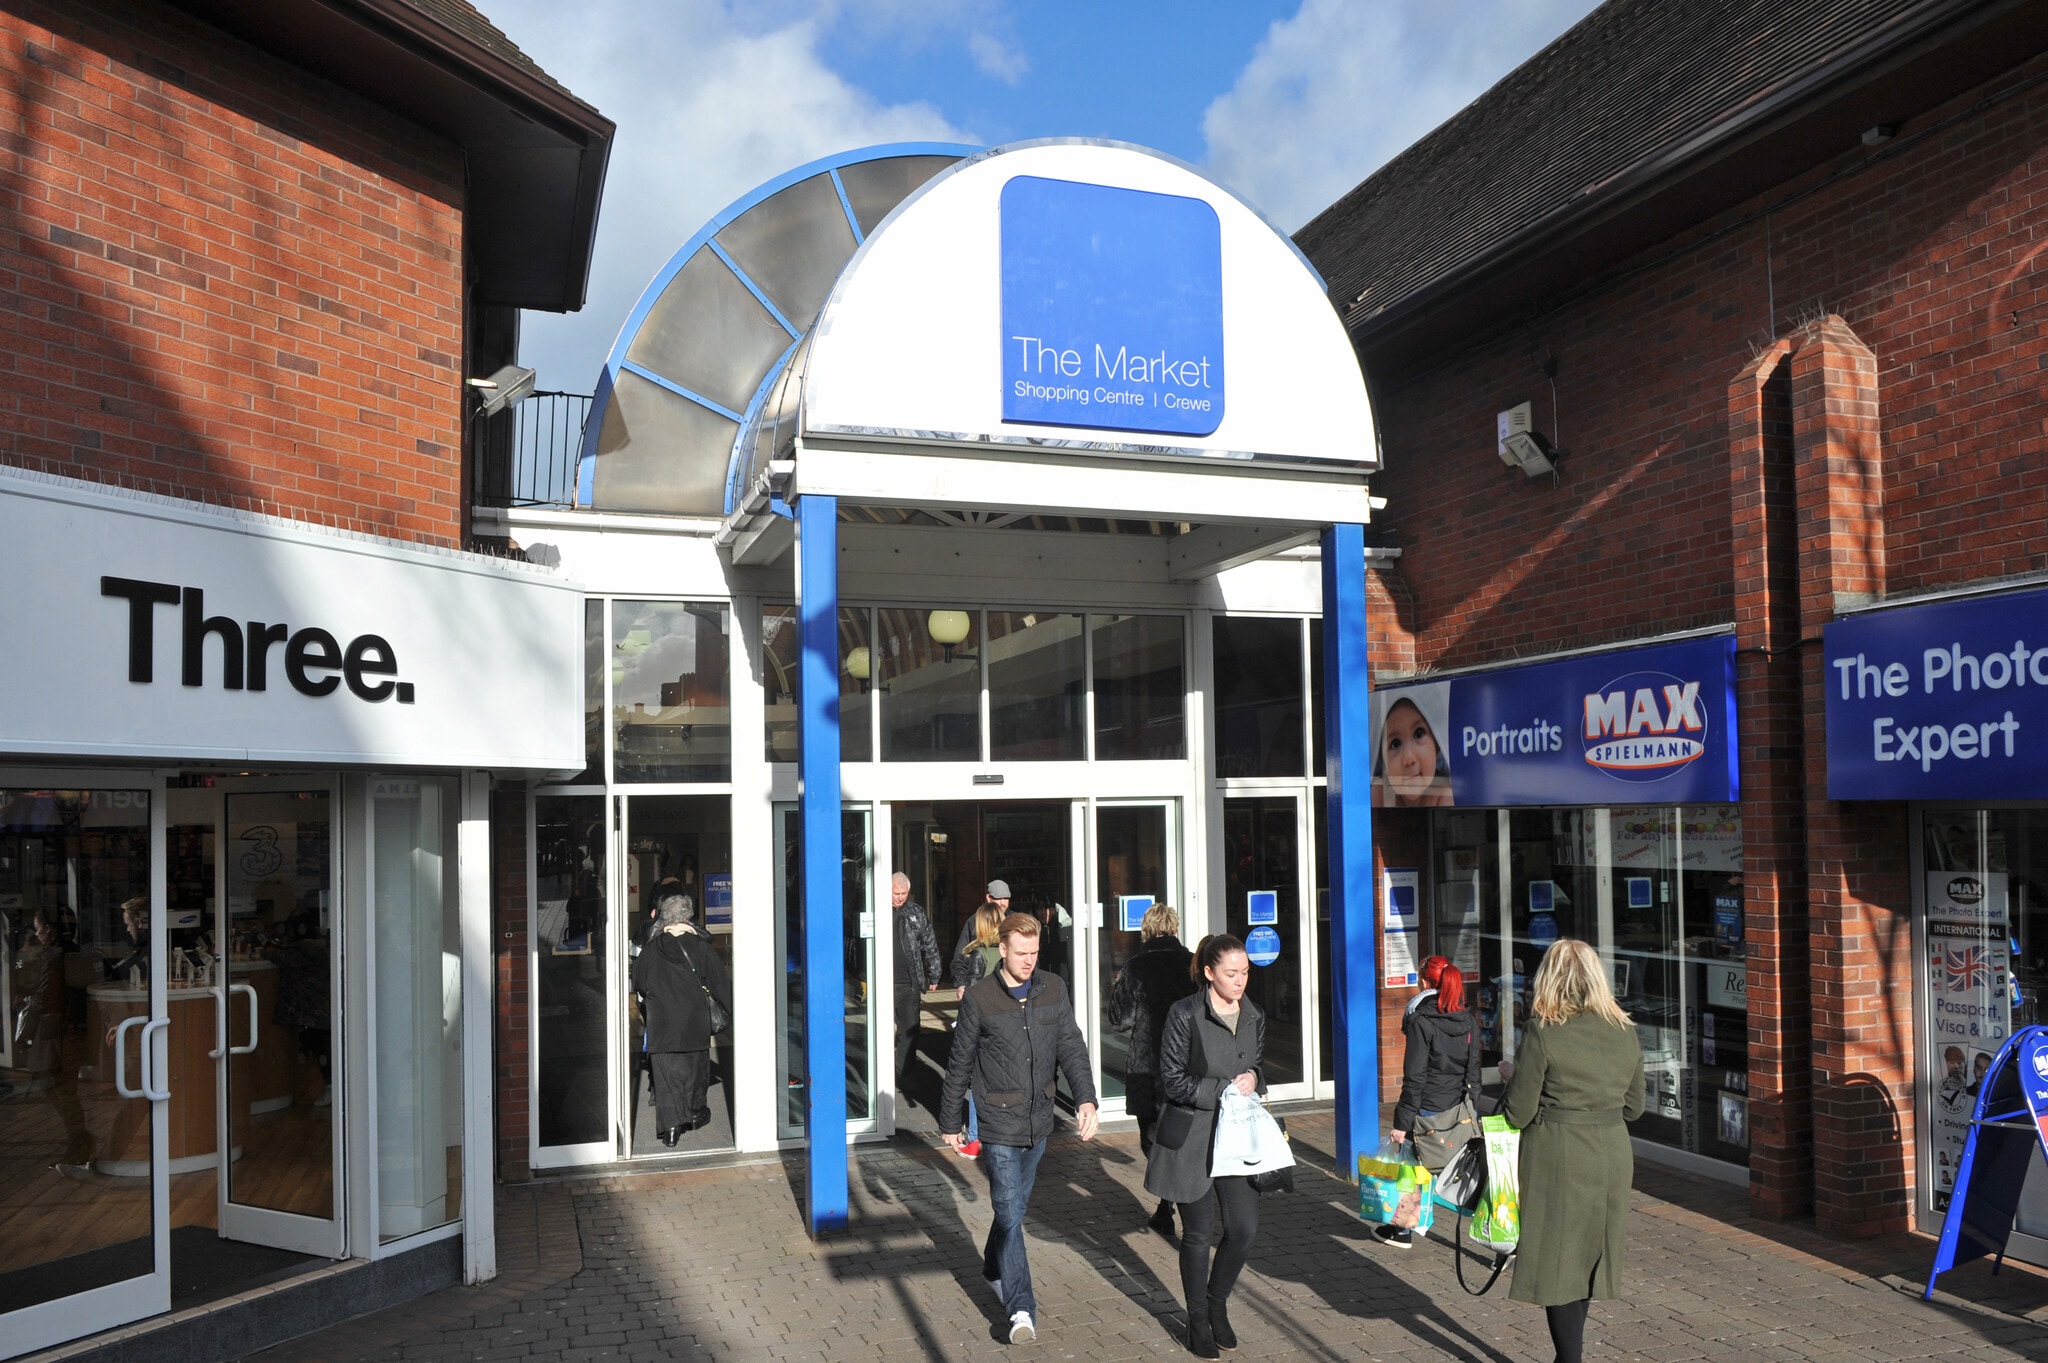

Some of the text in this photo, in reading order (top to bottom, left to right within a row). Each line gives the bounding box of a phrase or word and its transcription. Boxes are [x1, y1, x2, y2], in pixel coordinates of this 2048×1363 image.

[1012, 335, 1211, 389] The Market
[1014, 380, 1089, 405] Shopping
[1094, 386, 1145, 406] Centre
[1164, 393, 1211, 412] Crewe
[100, 575, 415, 705] Three.
[1833, 640, 2048, 700] The Photo
[1584, 681, 1702, 739] MAX
[1462, 717, 1562, 757] Portraits
[1873, 711, 2020, 773] Expert
[1595, 741, 1692, 761] SPIELMANN
[640, 840, 653, 851] sky
[1617, 831, 1637, 841] For
[1641, 832, 1662, 842] any
[1673, 850, 1705, 864] Wddings
[1950, 882, 1982, 895] MAX
[1716, 897, 1738, 908] MAX
[1932, 906, 2002, 918] The Photo Expert
[1934, 924, 2001, 938] INTERNATIONAL
[1725, 971, 1746, 992] Re
[1937, 998, 2001, 1022] Passport,
[1935, 1017, 1965, 1035] Visa
[1969, 1022, 1980, 1037] &
[1684, 1068, 1695, 1109] Photo
[1661, 1097, 1676, 1107] DVD
[1684, 1114, 1695, 1151] Exper
[1952, 1135, 1965, 1145] Stu
[1361, 1183, 1389, 1198] Pampers
